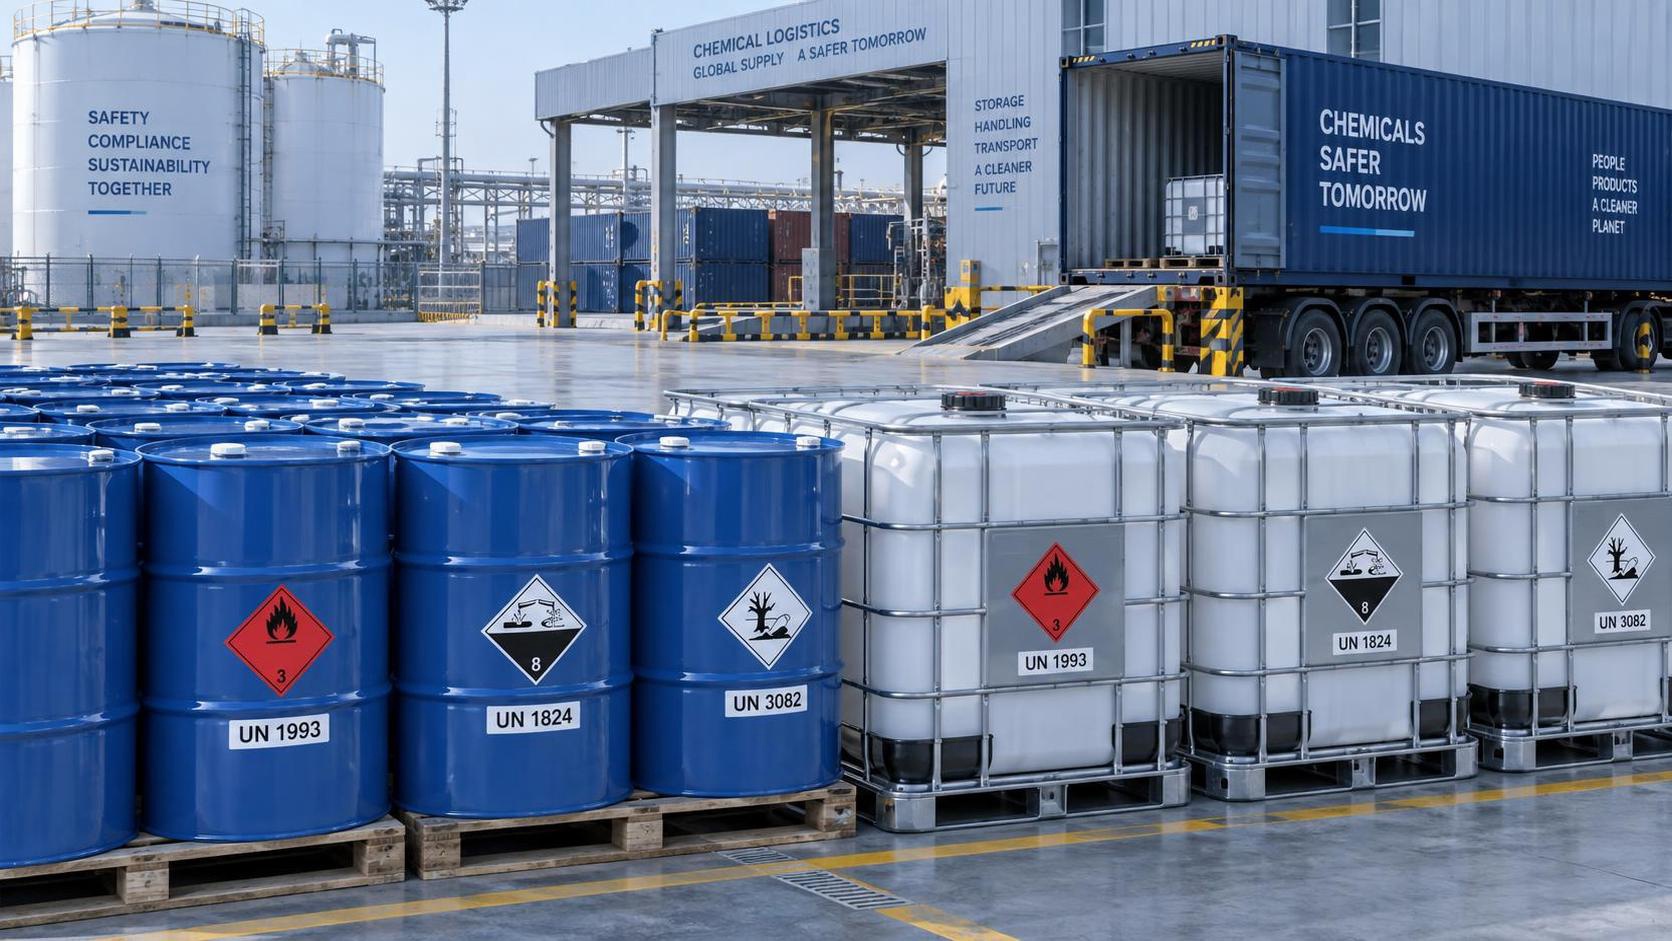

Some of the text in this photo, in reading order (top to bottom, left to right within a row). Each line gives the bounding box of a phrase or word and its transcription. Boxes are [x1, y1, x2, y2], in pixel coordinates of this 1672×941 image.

[693, 18, 840, 59] CHEMICAL LOGISTICS
[693, 27, 927, 80] GLOBAL SUPPLY A SAFER TOMORROW
[975, 95, 1024, 112] STORAGE
[88, 110, 150, 125] SAFETY
[975, 116, 1031, 133] HANDLING
[1320, 108, 1425, 145] CHEMICALS
[88, 134, 191, 150] COMPLIANCE
[975, 138, 1038, 154] TRANSPORT
[88, 158, 210, 174] SUSTAINABILITY
[975, 160, 1032, 176] A CLEANER
[1320, 145, 1381, 175] SAFER
[1592, 153, 1625, 171] PEOPLE
[88, 181, 172, 196] TOGETHER
[975, 181, 1016, 195] FUTURE
[1592, 176, 1638, 194] PRODUCTS
[1319, 181, 1427, 213] TOMORROW
[1592, 197, 1638, 215] A CLEANER
[1592, 218, 1625, 234] PLANET
[1361, 601, 1369, 614] 8
[1052, 618, 1060, 631] 3
[1599, 614, 1646, 629] UN 3082
[1338, 634, 1392, 651] UN 1824
[531, 657, 541, 672] 8
[1025, 652, 1087, 670] UN 1993
[277, 669, 286, 683] 3
[734, 692, 801, 711] UN 3082
[496, 707, 572, 728] UN 1824
[240, 721, 321, 743] UN 1993
